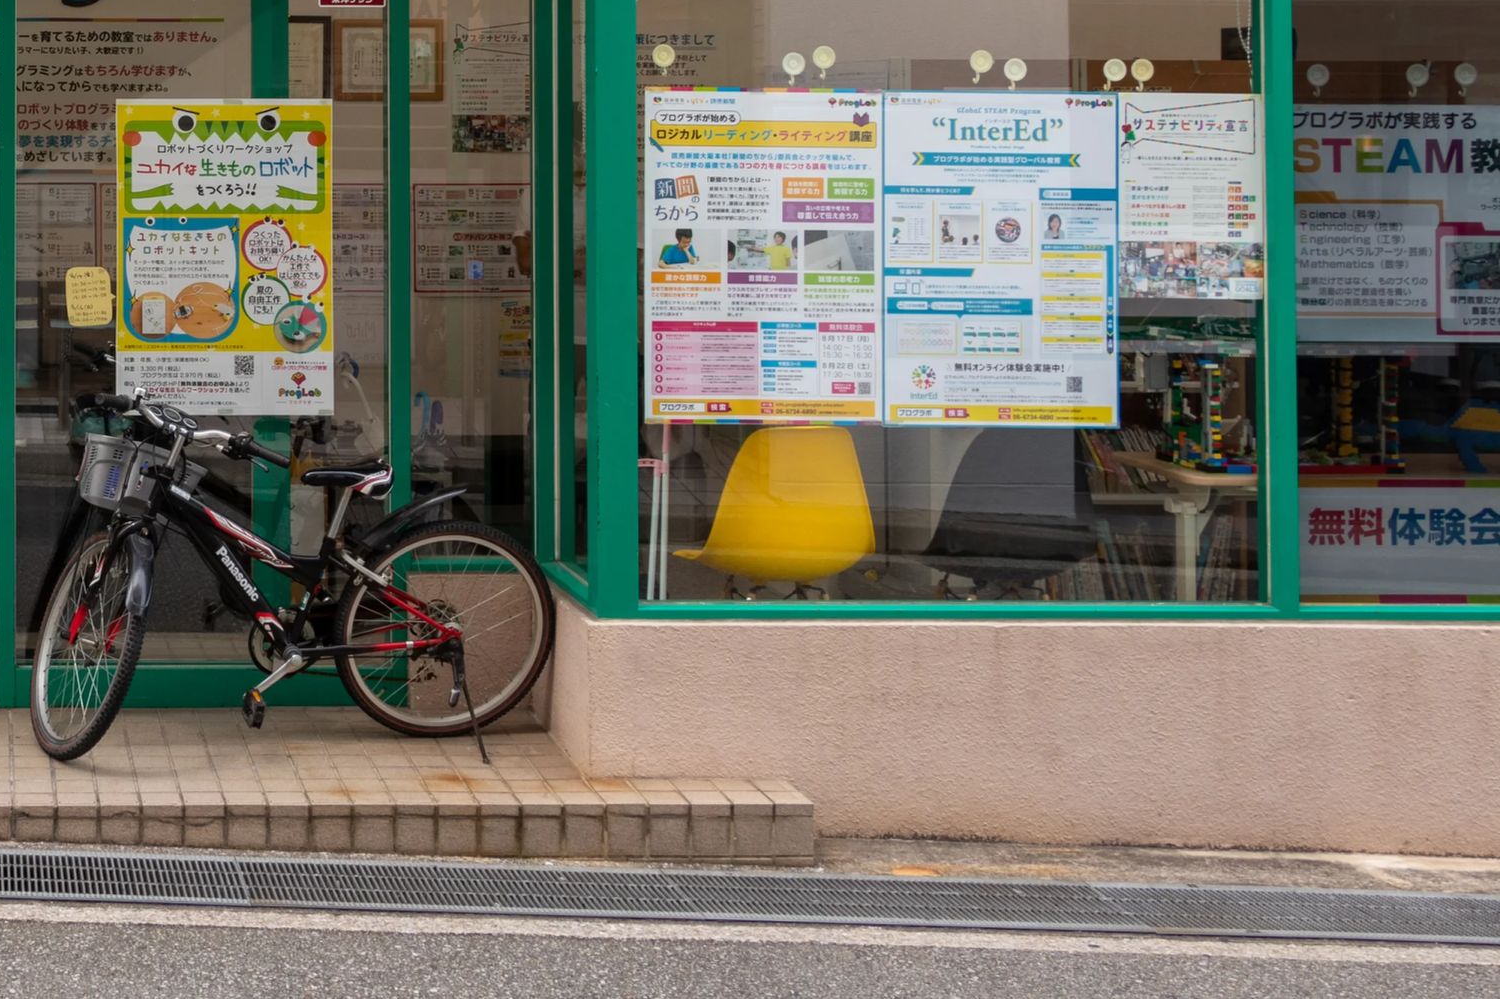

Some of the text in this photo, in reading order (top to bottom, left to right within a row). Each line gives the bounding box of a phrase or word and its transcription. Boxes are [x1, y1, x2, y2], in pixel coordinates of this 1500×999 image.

[838, 100, 877, 108] ProgLab
[1075, 99, 1113, 109] ProgLab
[1010, 108, 1041, 116] Program
[660, 113, 737, 123] プログラボが始める
[1293, 111, 1477, 130] プログラボが実践する
[1133, 118, 1249, 132] サステナビリティ宣言
[656, 128, 873, 143] ロジカルリーディング・ライティング講座
[157, 144, 293, 154] ロボットづくりワークショップ
[1294, 138, 1464, 174] STEAM
[655, 204, 699, 221] ちから
[1300, 210, 1347, 219] Science
[136, 232, 227, 242] ユカイな生きもの
[252, 231, 281, 239] つくった
[1300, 235, 1371, 245] Engineering
[143, 246, 219, 255] ロボットキット
[1300, 247, 1329, 256] Arts
[282, 254, 317, 263] かんたんな
[1299, 260, 1374, 269] Mathematics
[278, 388, 322, 399] ProgLab
[910, 391, 938, 400] InterEd
[661, 403, 696, 411] プログラボ
[899, 409, 933, 417] プログラボ
[1308, 507, 1500, 546] 無料体験会
[216, 545, 260, 602] Panasonic
